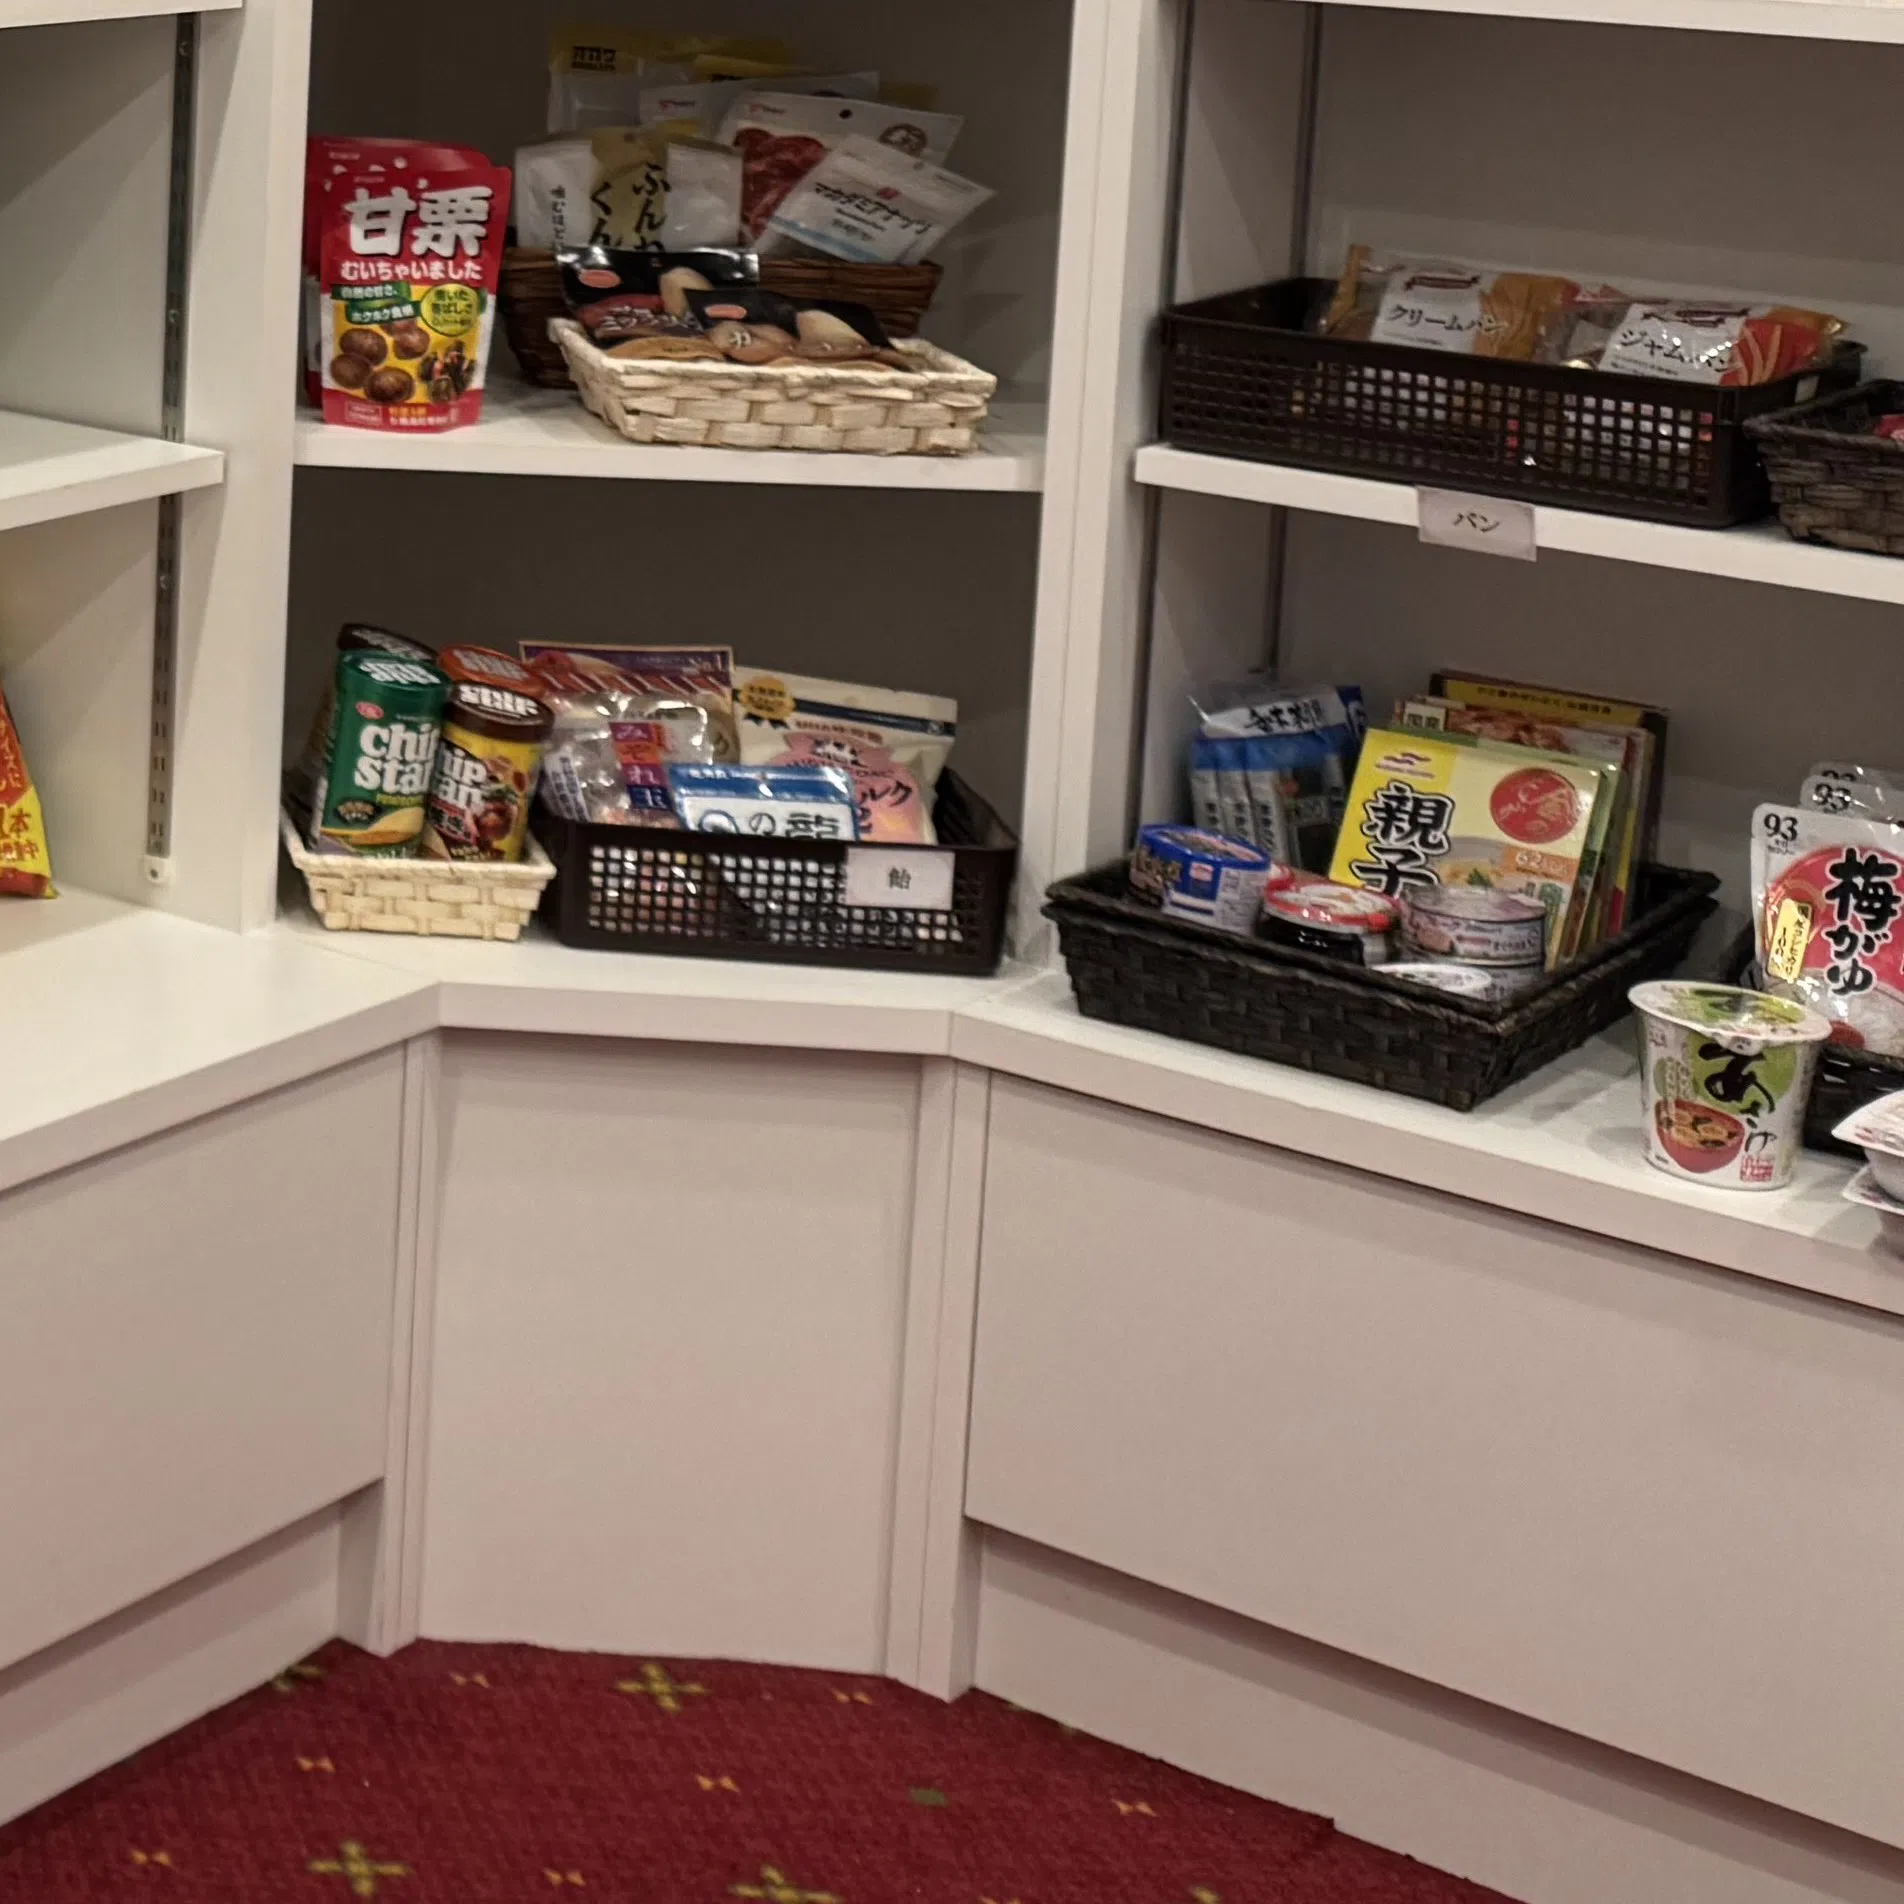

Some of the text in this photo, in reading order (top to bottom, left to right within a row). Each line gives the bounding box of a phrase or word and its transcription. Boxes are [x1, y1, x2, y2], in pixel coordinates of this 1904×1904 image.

[344, 187, 493, 257] 甘栗
[341, 261, 483, 280] むいちゃいました
[1387, 304, 1504, 336] クリームパン
[1453, 512, 1502, 533] パン
[1350, 780, 1455, 897] 親子
[1764, 812, 1799, 841] 93
[1825, 847, 1901, 996] 梅がゆ
